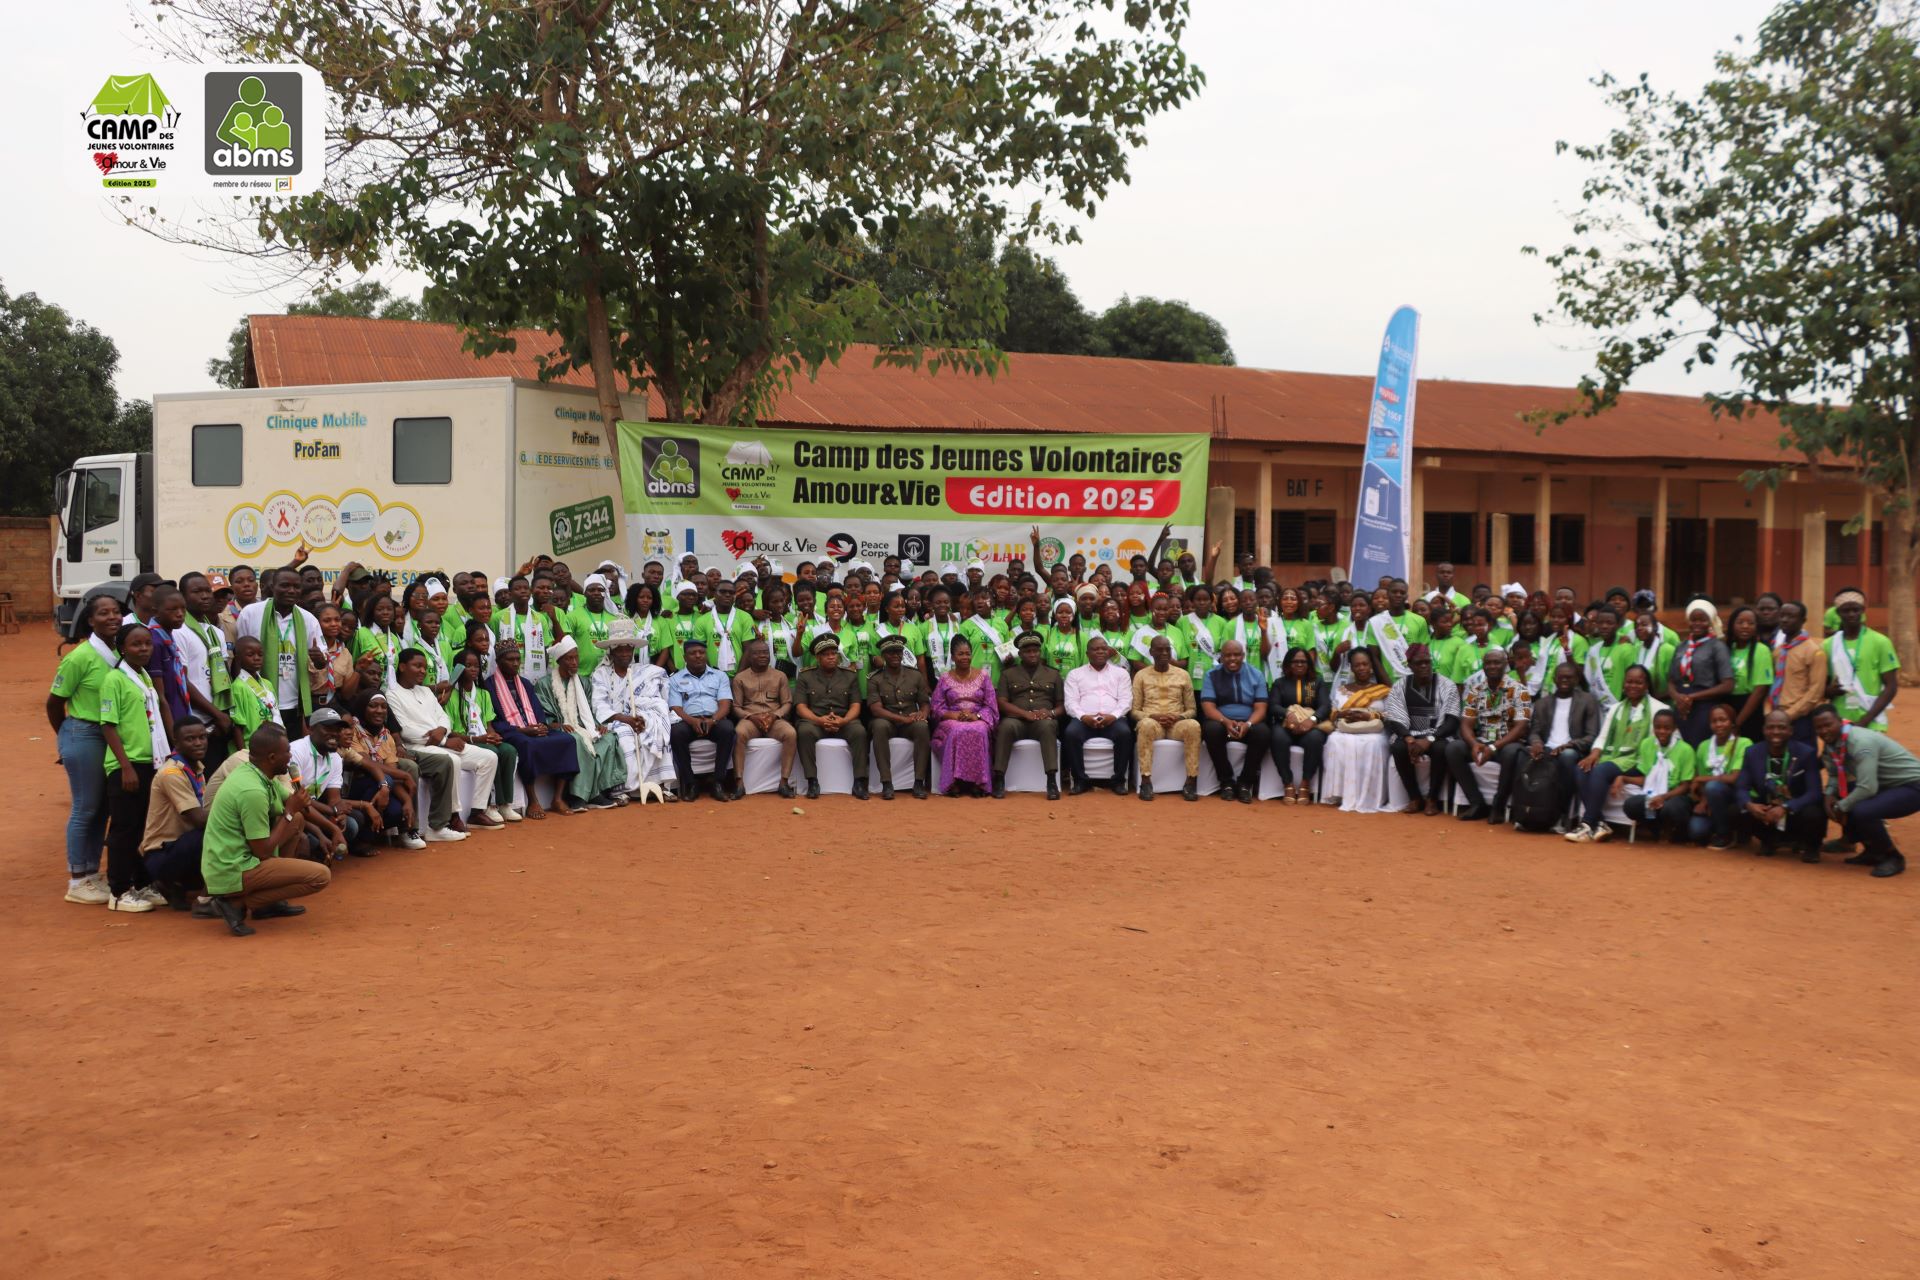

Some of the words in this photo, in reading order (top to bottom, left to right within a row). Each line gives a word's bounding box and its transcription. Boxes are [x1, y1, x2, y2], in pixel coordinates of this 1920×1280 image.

[266, 415, 318, 431] Clinique
[322, 411, 368, 428] Mobile
[555, 407, 587, 422] Clinique
[572, 431, 600, 445] ProFam
[294, 441, 340, 458] ProFam
[793, 440, 870, 471] Camp
[876, 443, 924, 470] des
[930, 445, 1024, 472] Jeunes
[1029, 446, 1183, 474] Volontaires
[553, 455, 584, 466] SERVICES
[721, 466, 766, 481] CAMP
[648, 478, 696, 495] abms
[1287, 479, 1309, 497] BAT
[1315, 479, 1324, 497] F
[969, 484, 1070, 510] Edition
[1083, 486, 1155, 511] 2025
[573, 506, 610, 534] 7344
[782, 540, 792, 553] &
[795, 537, 817, 553] Vie
[861, 541, 890, 550] Peace
[861, 549, 889, 558] Corps
